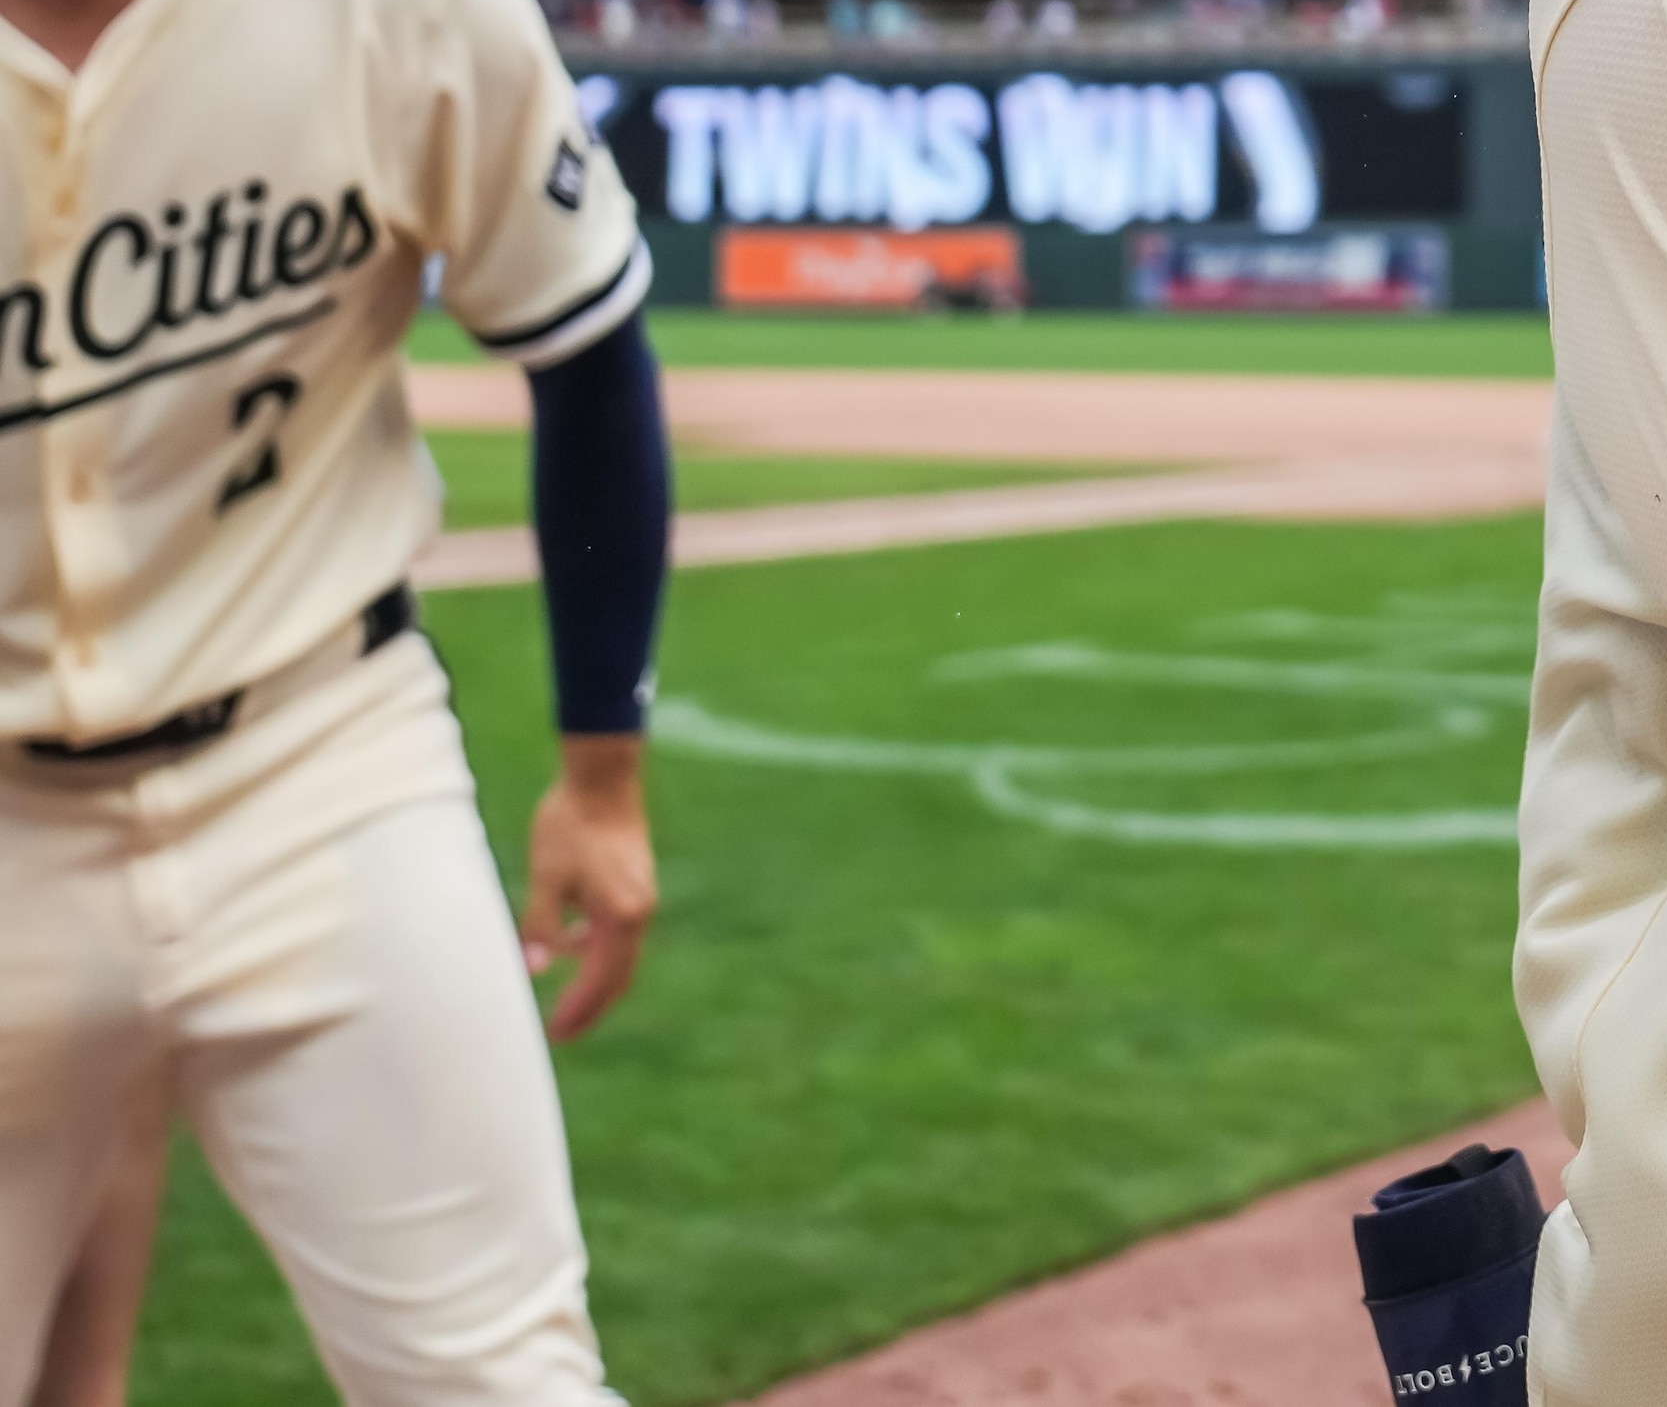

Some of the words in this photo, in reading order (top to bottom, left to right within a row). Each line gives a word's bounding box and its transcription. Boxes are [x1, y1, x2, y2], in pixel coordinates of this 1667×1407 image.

[655, 75, 994, 230] TWINS
[68, 177, 379, 359] Cities
[214, 371, 301, 515] 2
